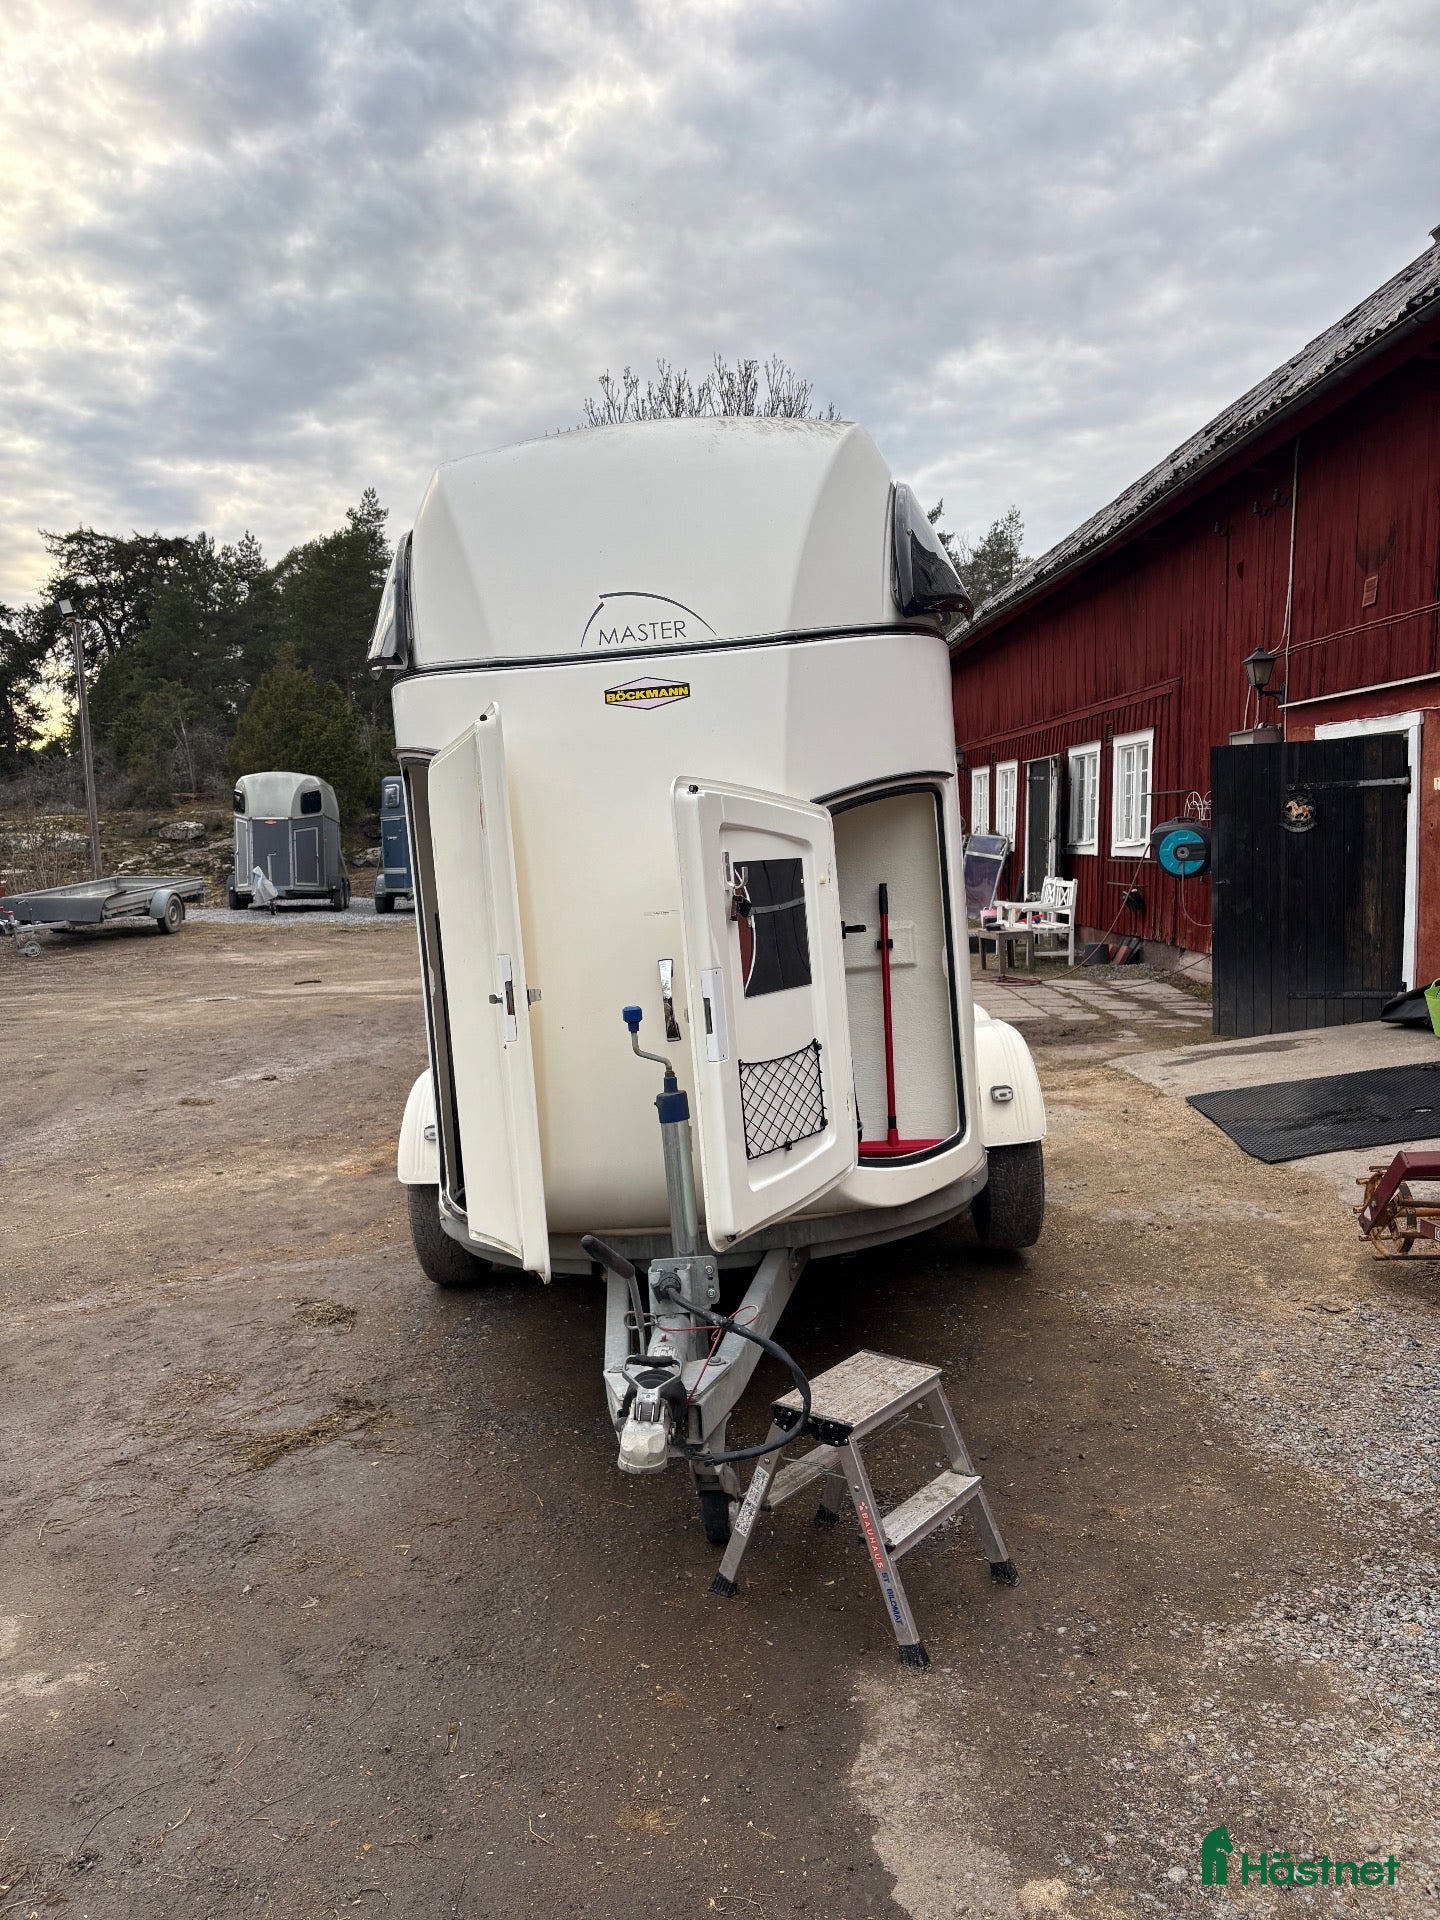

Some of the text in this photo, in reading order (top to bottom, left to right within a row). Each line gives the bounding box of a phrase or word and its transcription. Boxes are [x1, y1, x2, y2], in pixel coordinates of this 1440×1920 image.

[599, 620, 686, 646] MASTER
[605, 686, 689, 703] BÖCKMANN
[861, 1512, 884, 1569] BAUHAUS
